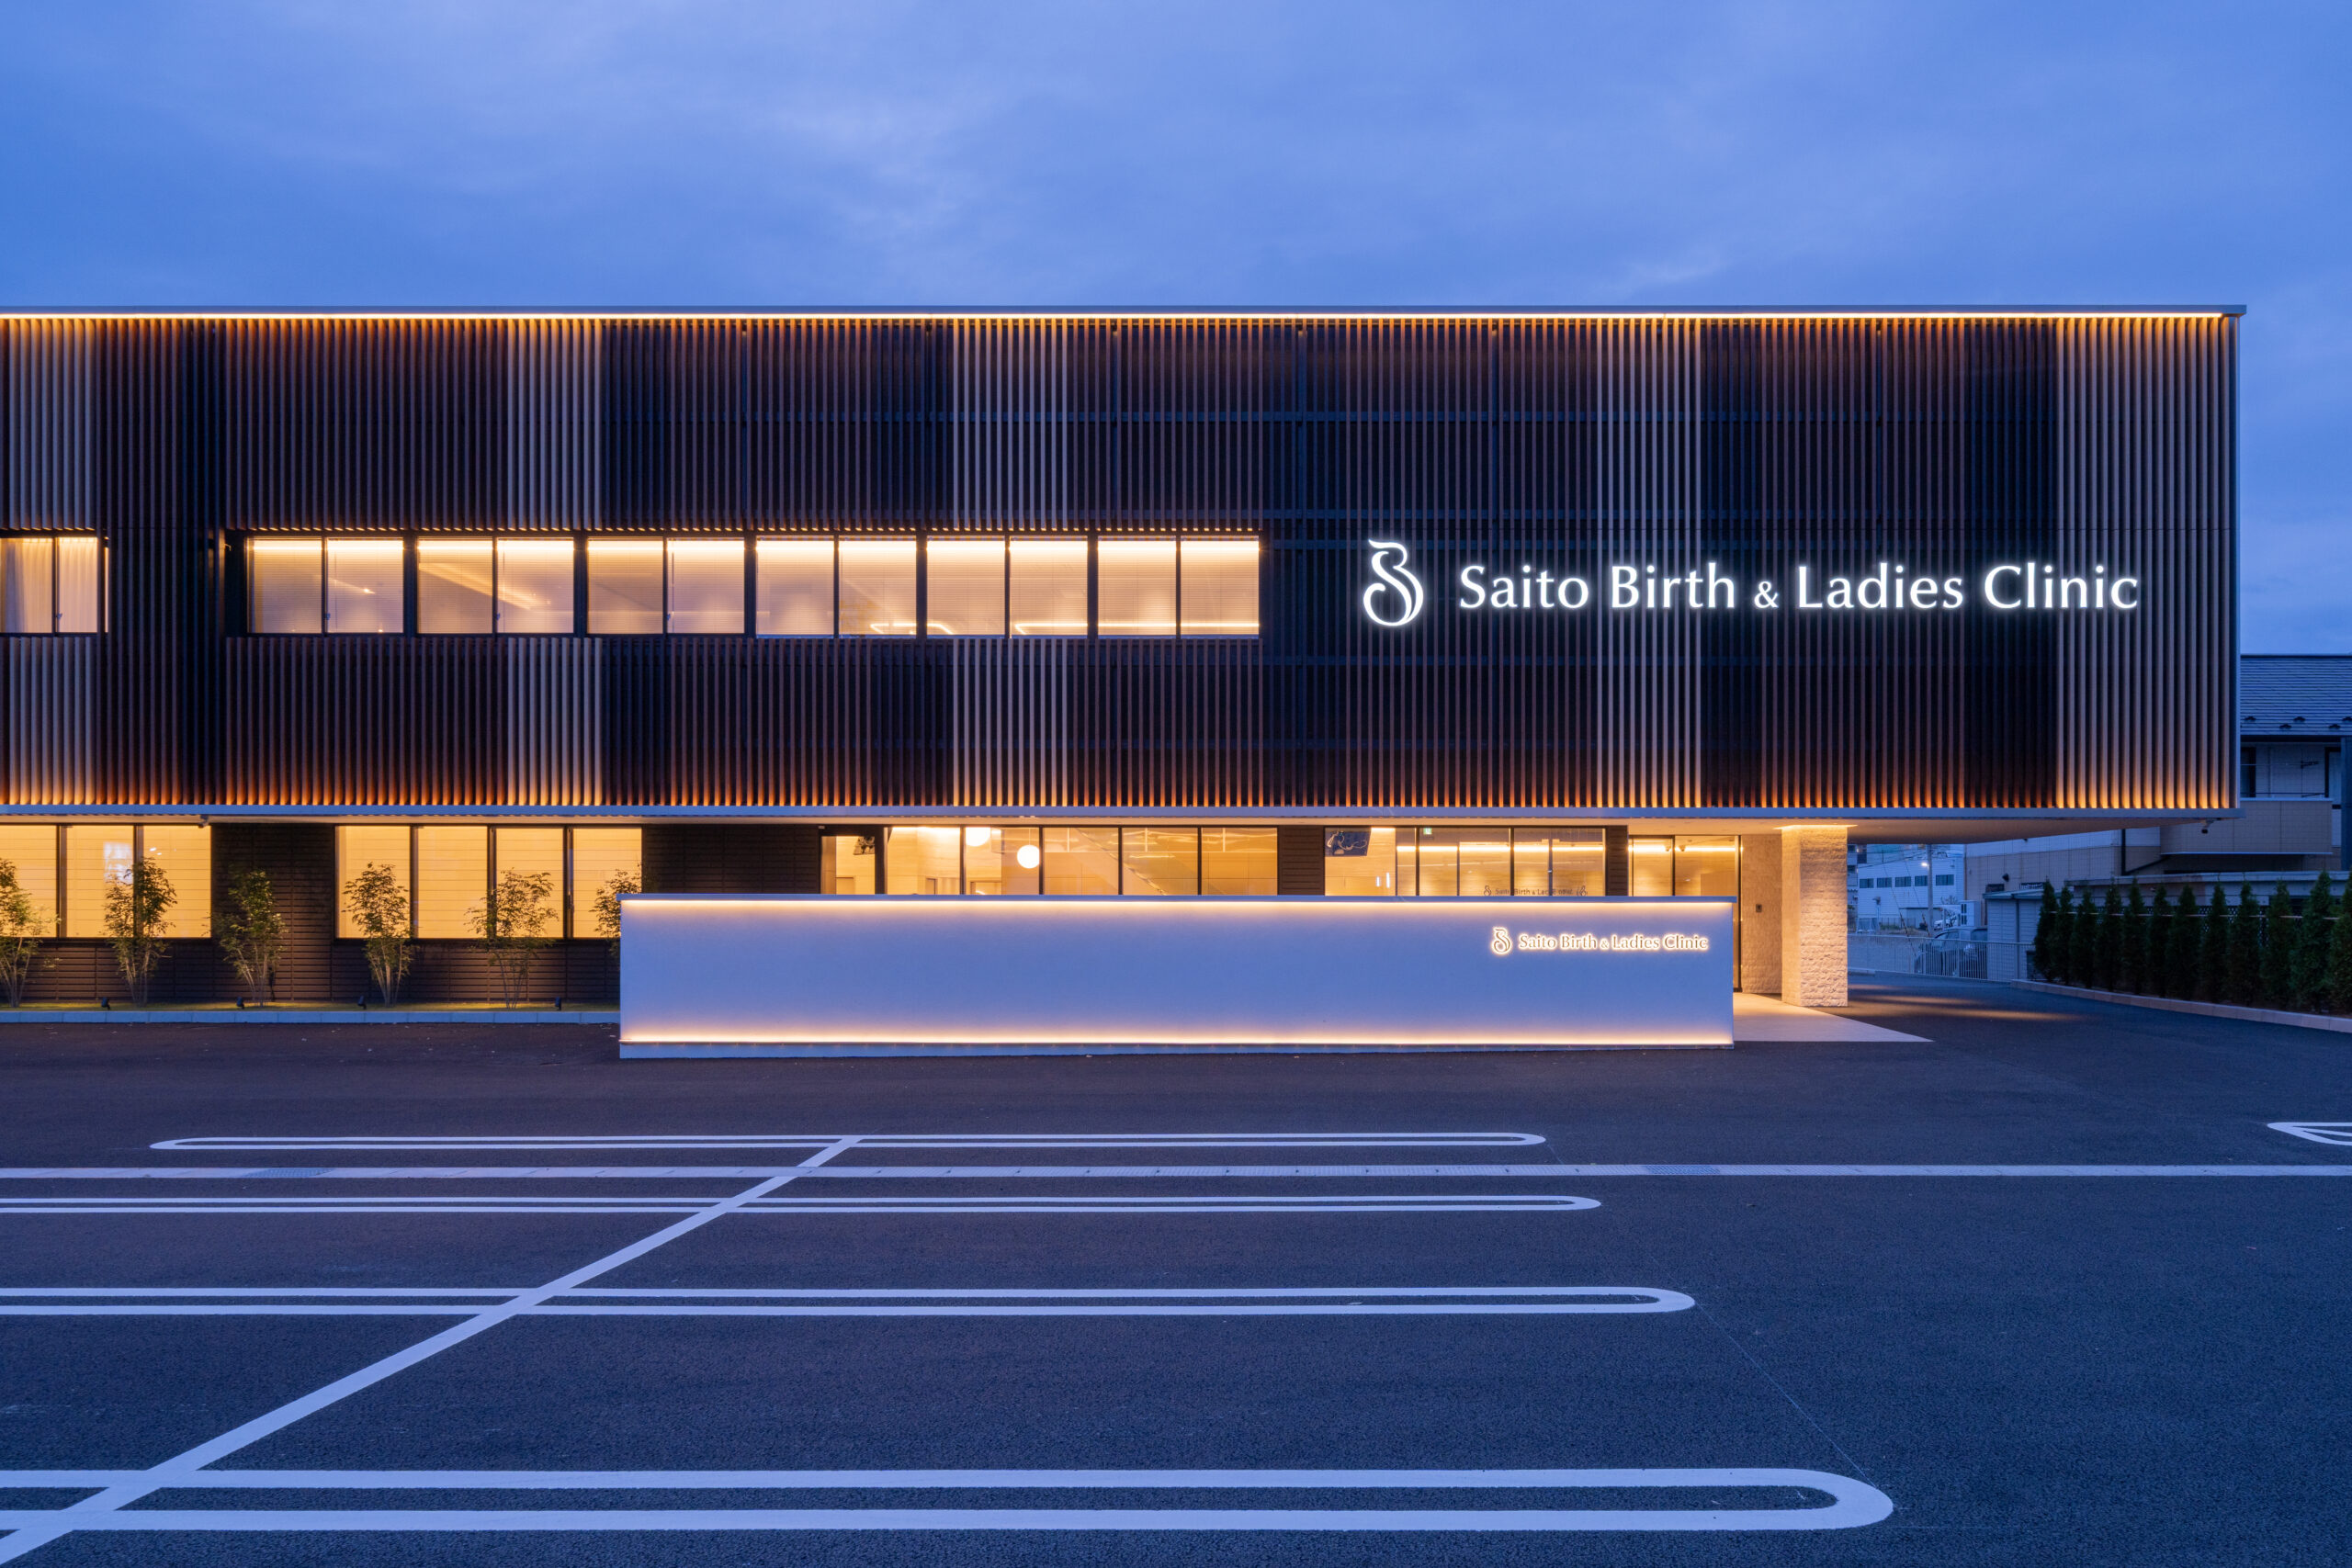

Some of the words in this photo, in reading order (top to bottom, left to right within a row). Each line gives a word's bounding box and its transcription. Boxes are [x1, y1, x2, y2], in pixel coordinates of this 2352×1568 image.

[1460, 564, 1589, 609] Saito
[1611, 562, 1735, 608] Birth
[1754, 580, 1780, 609] &
[1798, 562, 1964, 609] Ladies
[1984, 562, 2139, 609] Clinic
[1519, 934, 1557, 950] Saito
[1561, 934, 1597, 950] Birth
[1600, 939, 1610, 949] &
[1612, 934, 1660, 950] Ladies
[1664, 934, 1708, 950] Clinic
